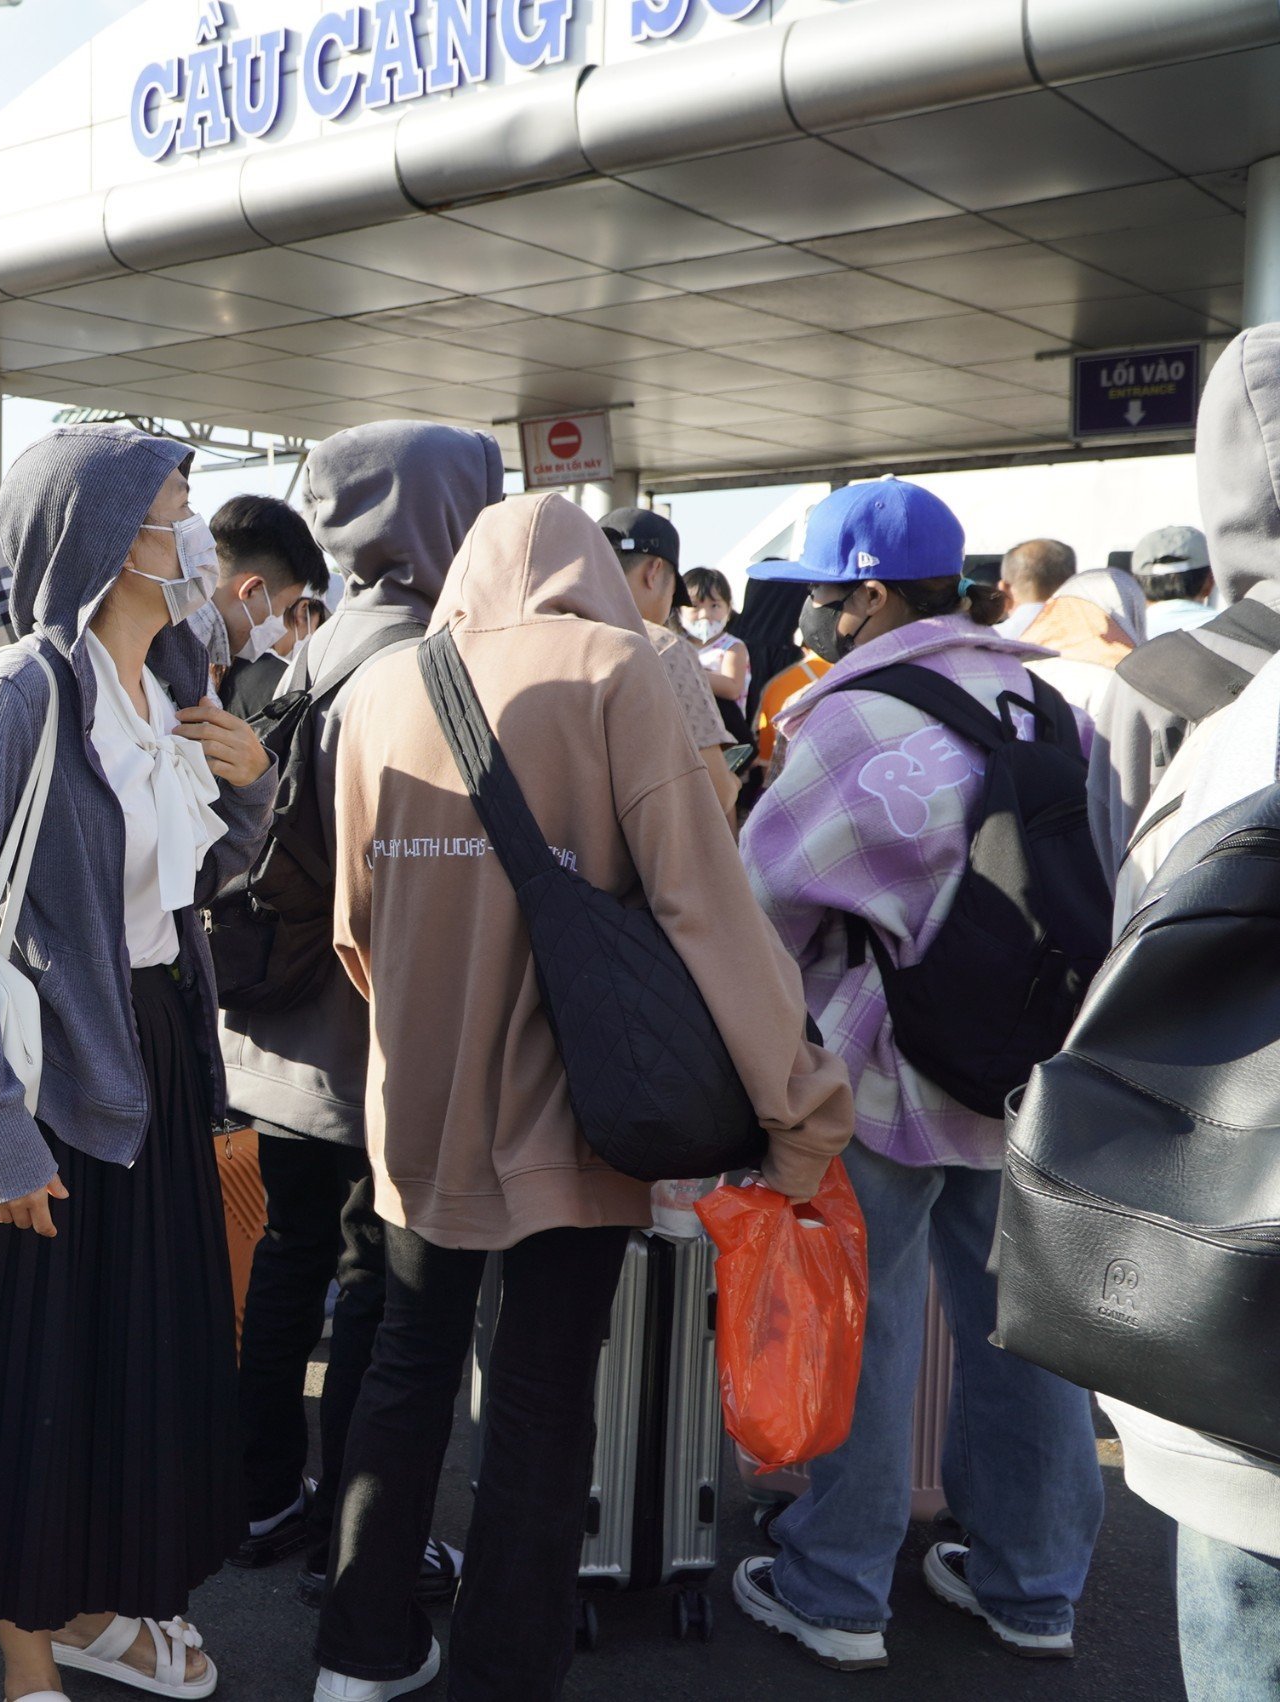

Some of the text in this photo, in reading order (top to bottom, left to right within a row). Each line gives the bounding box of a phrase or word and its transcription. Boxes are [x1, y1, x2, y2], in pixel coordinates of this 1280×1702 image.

[130, 0, 286, 162] CẦU
[1100, 358, 1185, 387] LỐI VÀO
[1109, 384, 1176, 399] ENTRANCE
[404, 838, 440, 857] WITH
